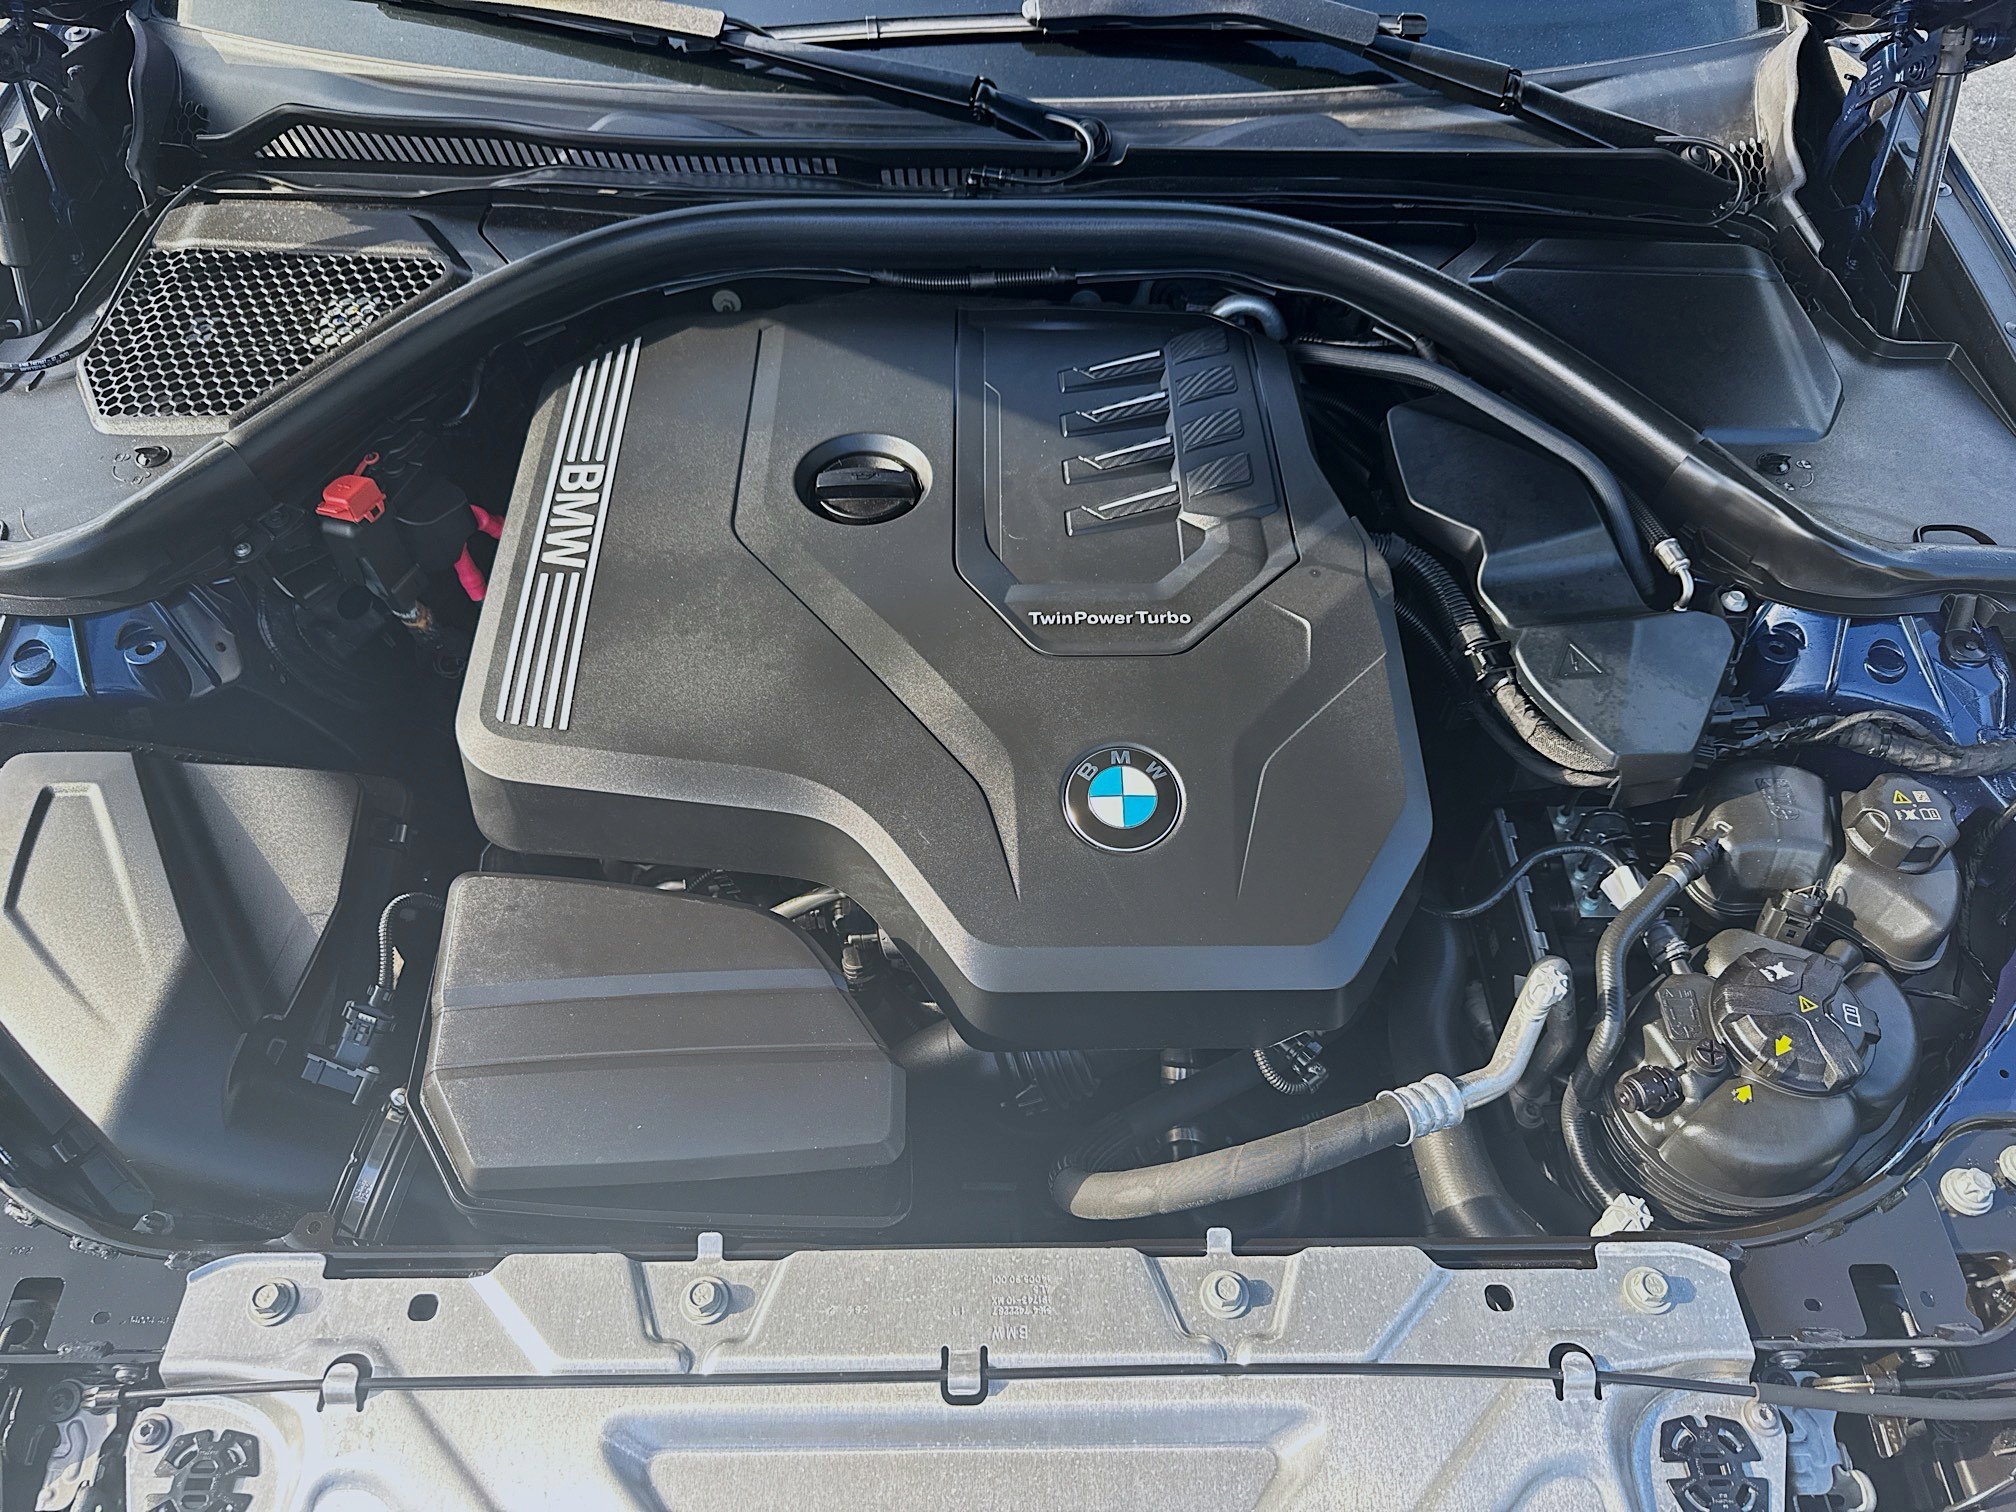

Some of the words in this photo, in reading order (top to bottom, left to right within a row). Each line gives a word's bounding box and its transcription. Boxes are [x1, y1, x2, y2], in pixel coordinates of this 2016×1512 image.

[541, 464, 606, 569] BMW
[1028, 611, 1134, 625] TwinPower
[1135, 611, 1192, 625] Turbo
[1076, 750, 1168, 782] BMW
[991, 1325, 1028, 1341] BMW
